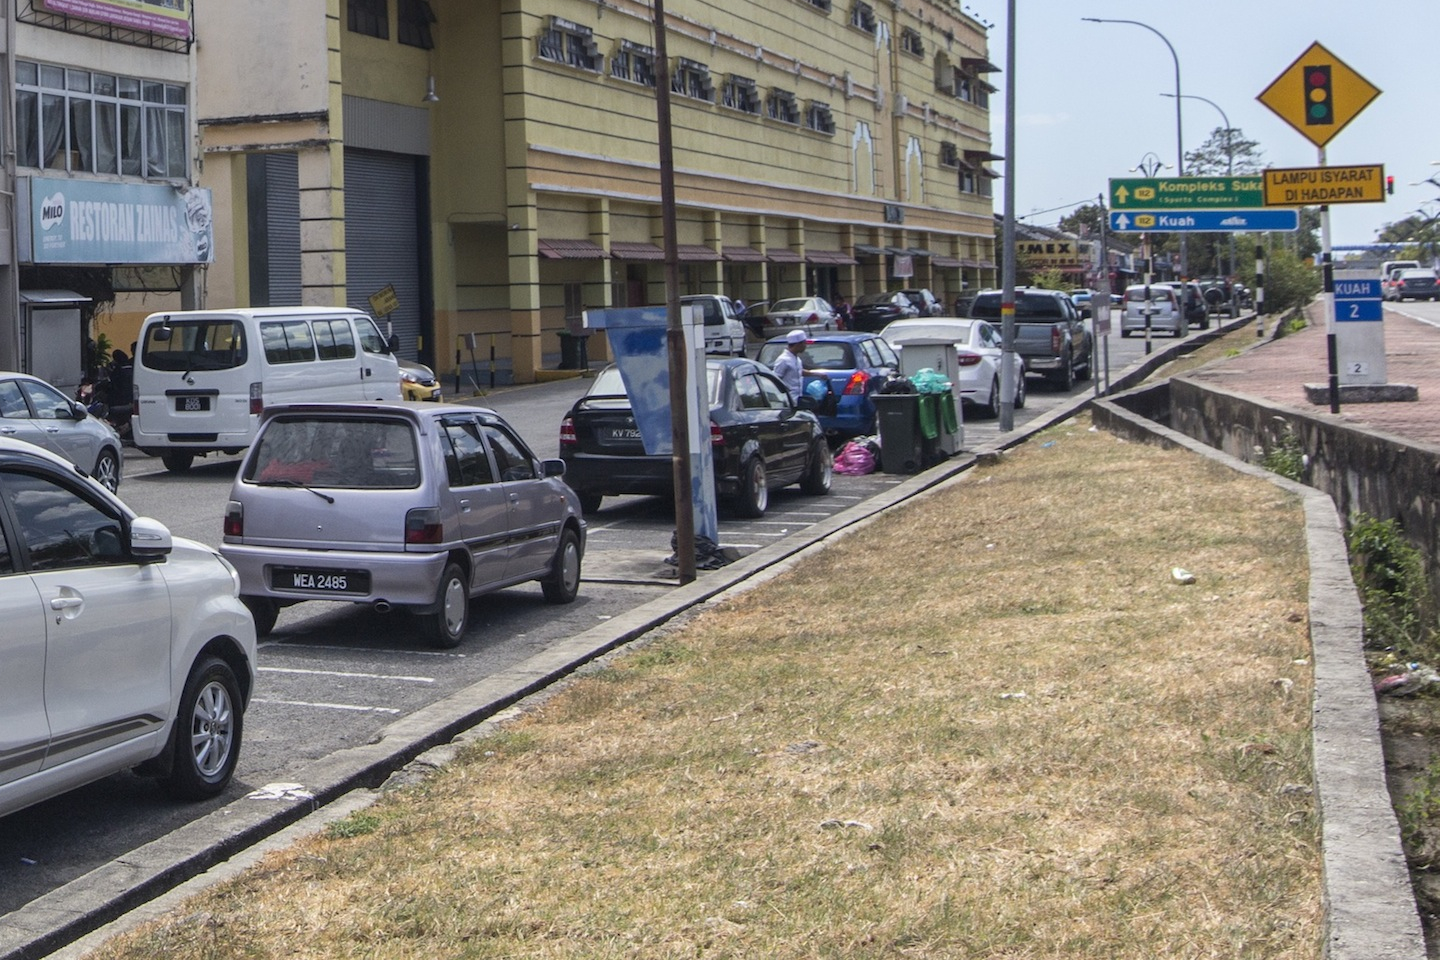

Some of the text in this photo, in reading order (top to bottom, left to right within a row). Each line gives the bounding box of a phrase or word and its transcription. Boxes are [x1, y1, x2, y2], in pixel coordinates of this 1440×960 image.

[1273, 169, 1374, 185] LAMPU ISYARAT
[1159, 181, 1225, 194] Kompleks
[1285, 187, 1363, 201] DI HADAPAN
[42, 204, 63, 221] MILO
[69, 200, 135, 241] RESTORAN
[1159, 215, 1195, 226] Kuah
[1335, 282, 1371, 295] KUAH
[1349, 304, 1359, 318] 2
[1354, 363, 1362, 373] 2
[293, 573, 347, 589] WEA 2485
